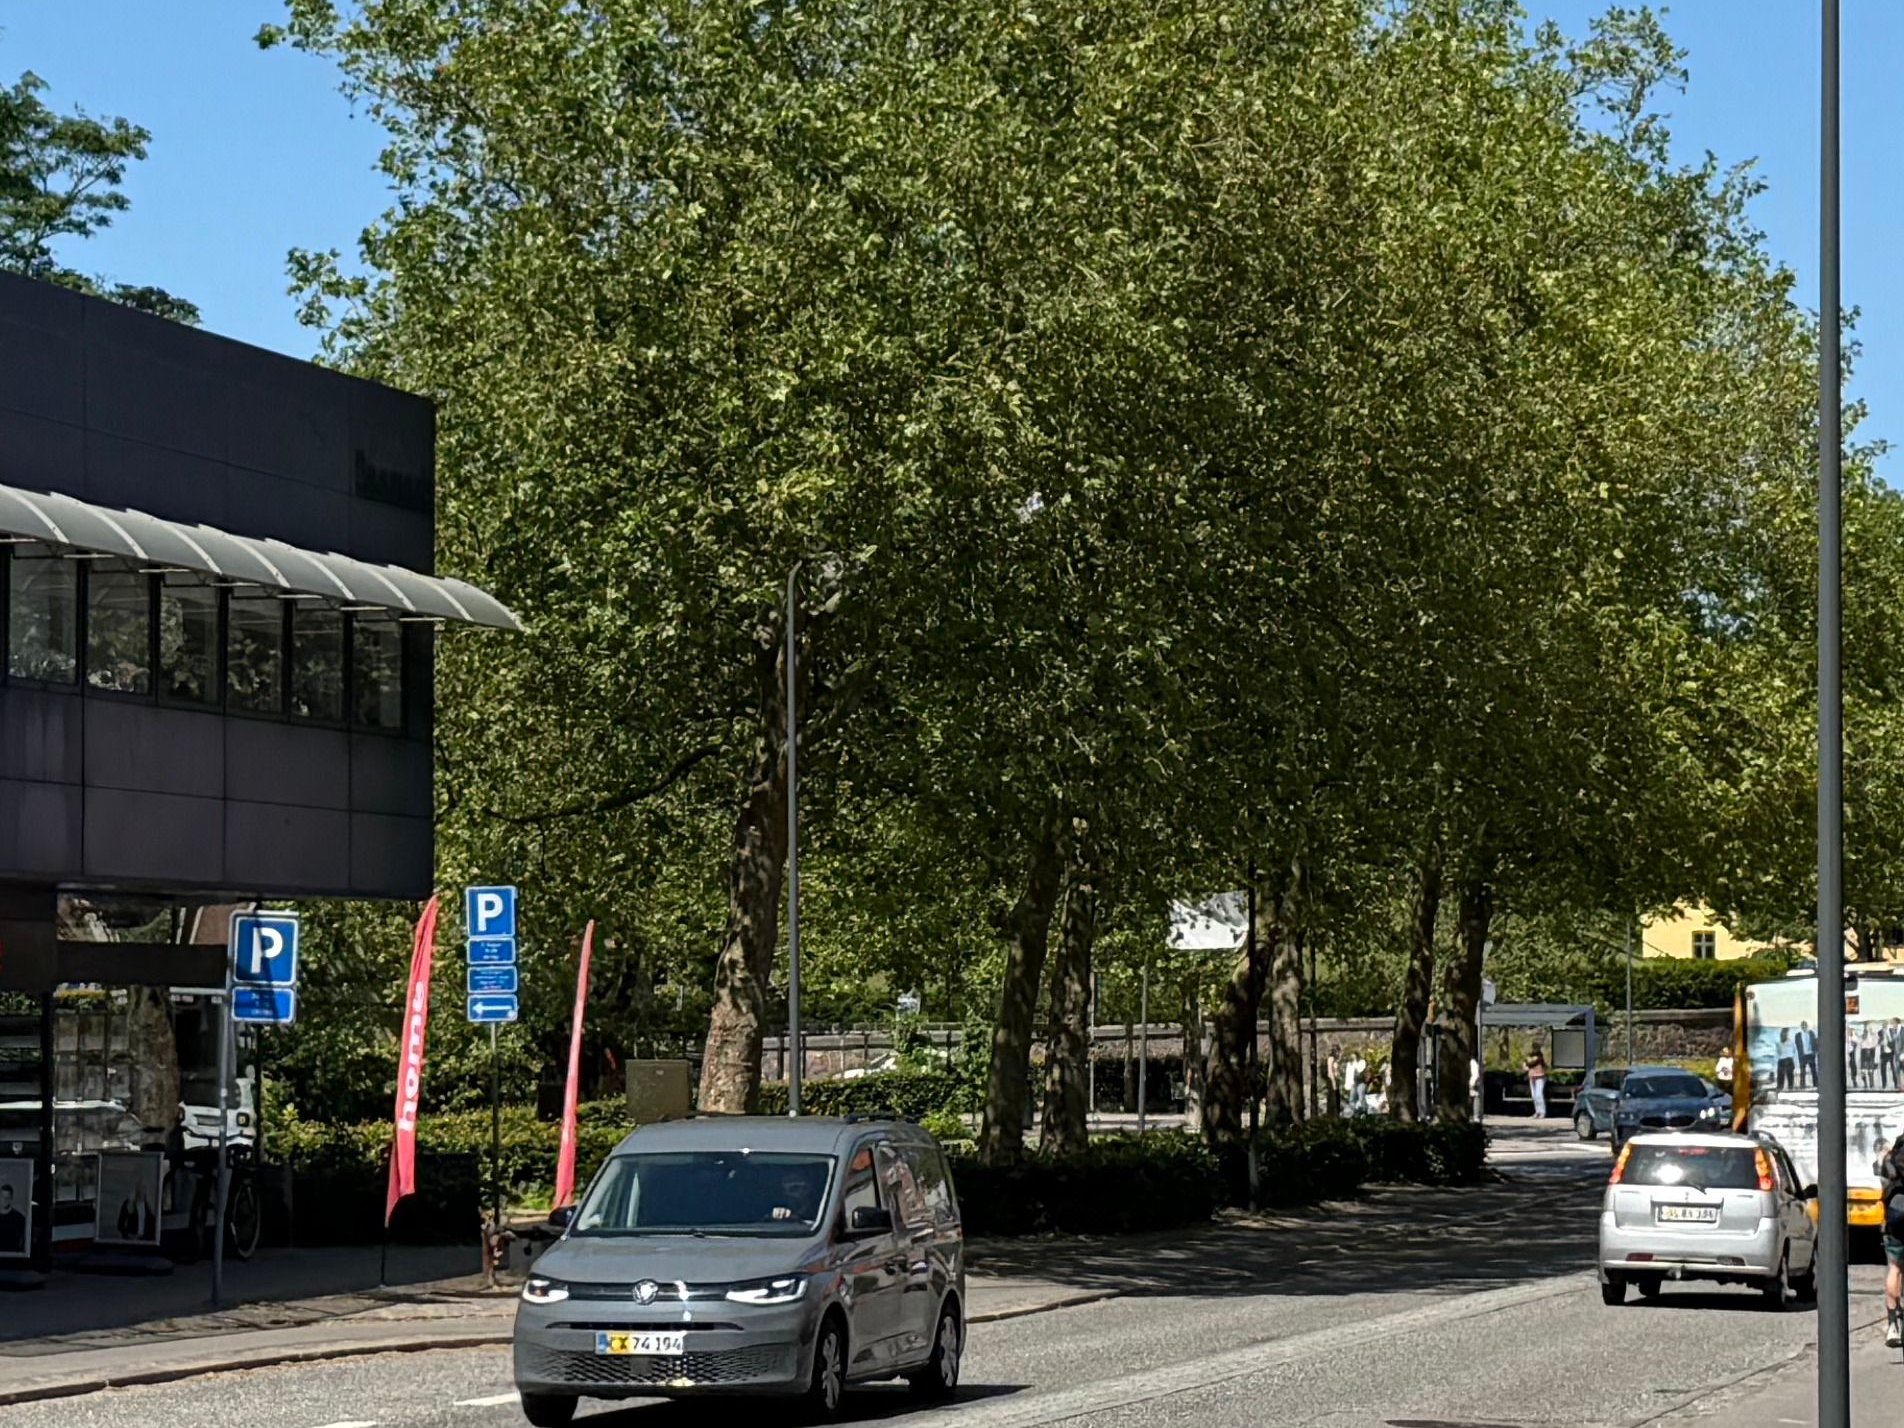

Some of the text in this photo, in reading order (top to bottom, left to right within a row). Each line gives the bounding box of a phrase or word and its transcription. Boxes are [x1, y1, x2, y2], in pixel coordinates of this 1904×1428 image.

[477, 892, 504, 932] P
[250, 926, 284, 974] P
[398, 980, 425, 1132] home
